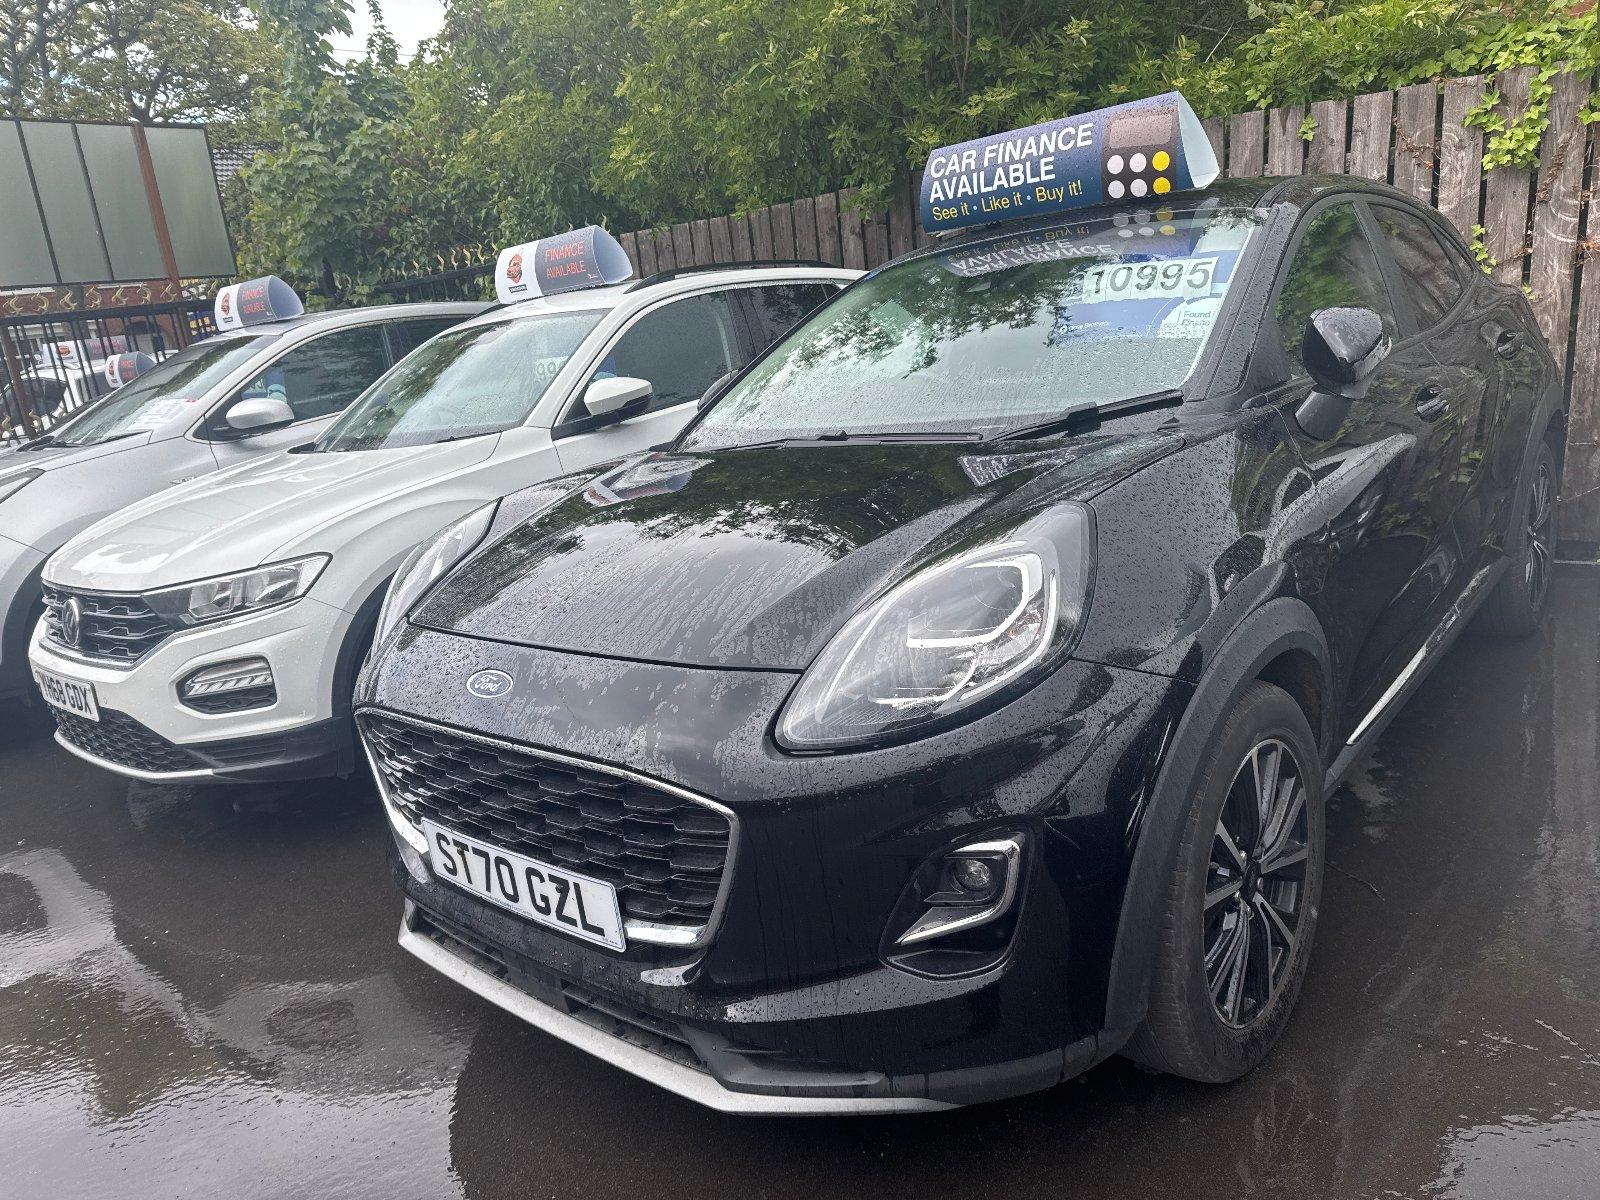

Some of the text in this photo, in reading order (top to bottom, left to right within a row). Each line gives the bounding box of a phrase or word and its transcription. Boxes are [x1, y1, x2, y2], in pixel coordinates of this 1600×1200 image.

[930, 123, 1094, 179] CAR FINANCE
[928, 156, 1056, 203] AVAILABLE
[932, 180, 1083, 222] See it Like it Buy it!
[544, 242, 584, 262] FINANCE
[546, 261, 587, 280] AVAILABLE
[1091, 261, 1213, 294] 10995
[65, 683, 92, 714] GDX
[435, 832, 606, 938] ST70 GZL
